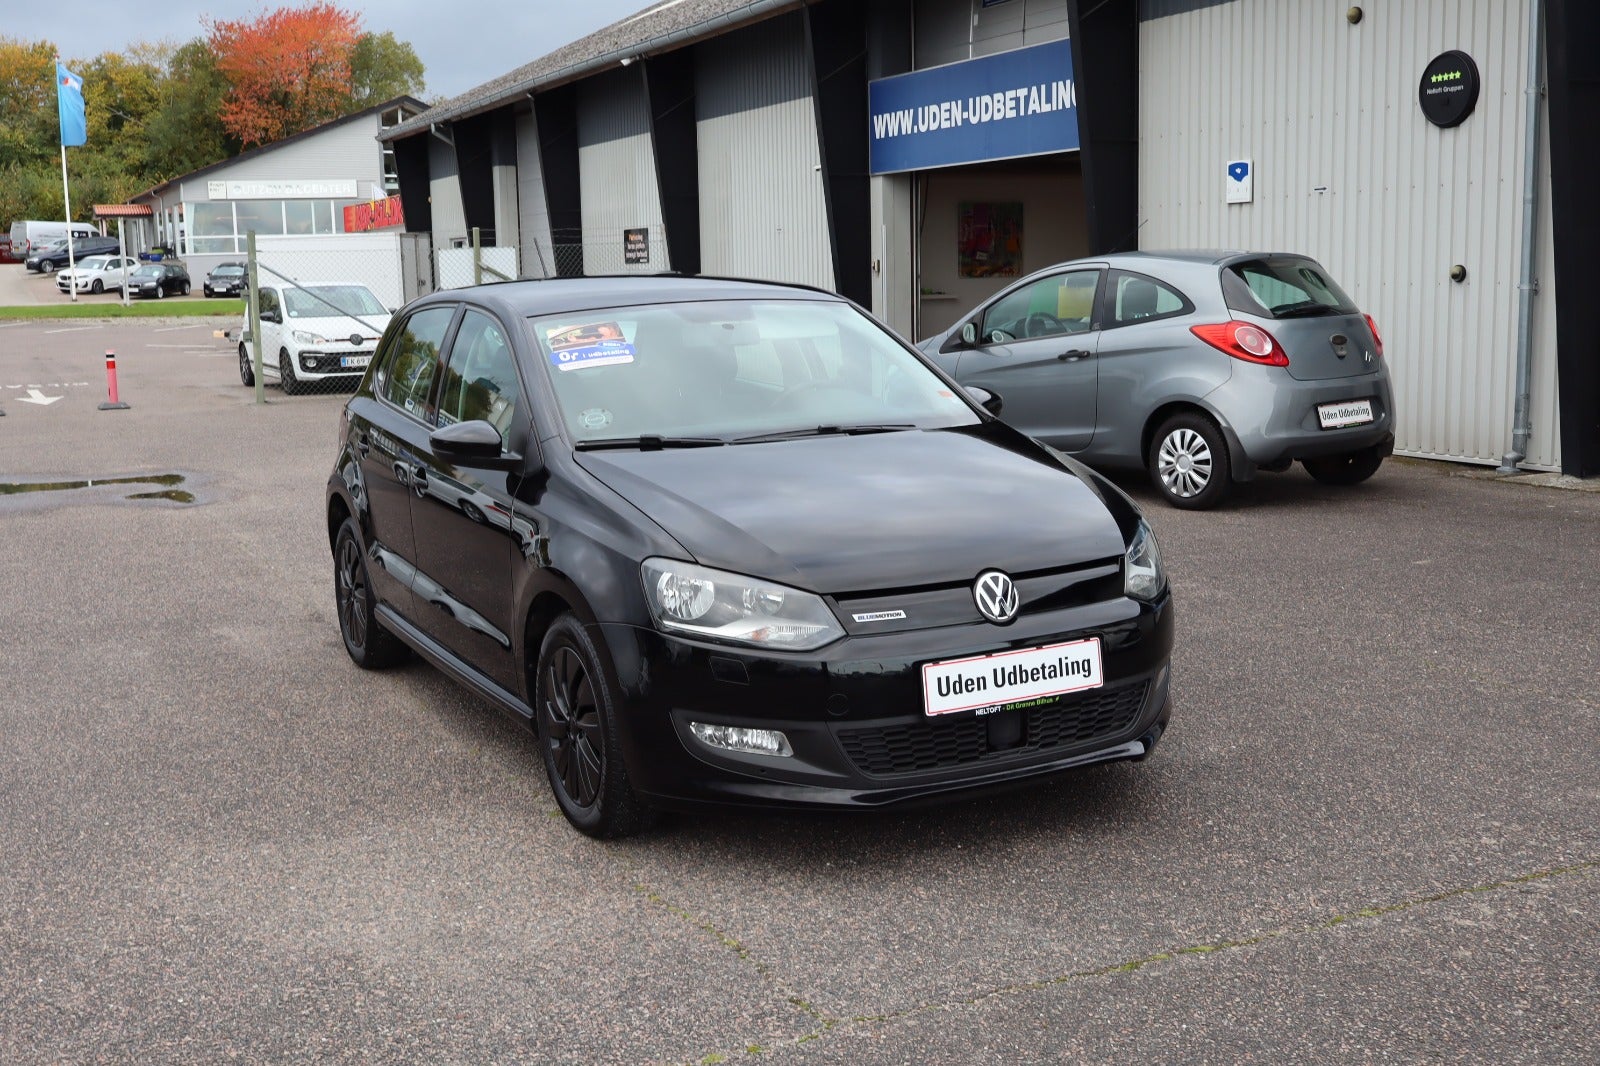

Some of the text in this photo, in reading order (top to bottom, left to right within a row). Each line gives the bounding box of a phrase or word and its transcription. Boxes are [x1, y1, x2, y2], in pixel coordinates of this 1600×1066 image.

[857, 611, 903, 621] BLUEMOTION
[937, 655, 1093, 698] Uden Udbetaling
[975, 705, 1002, 717] NELTOFT
